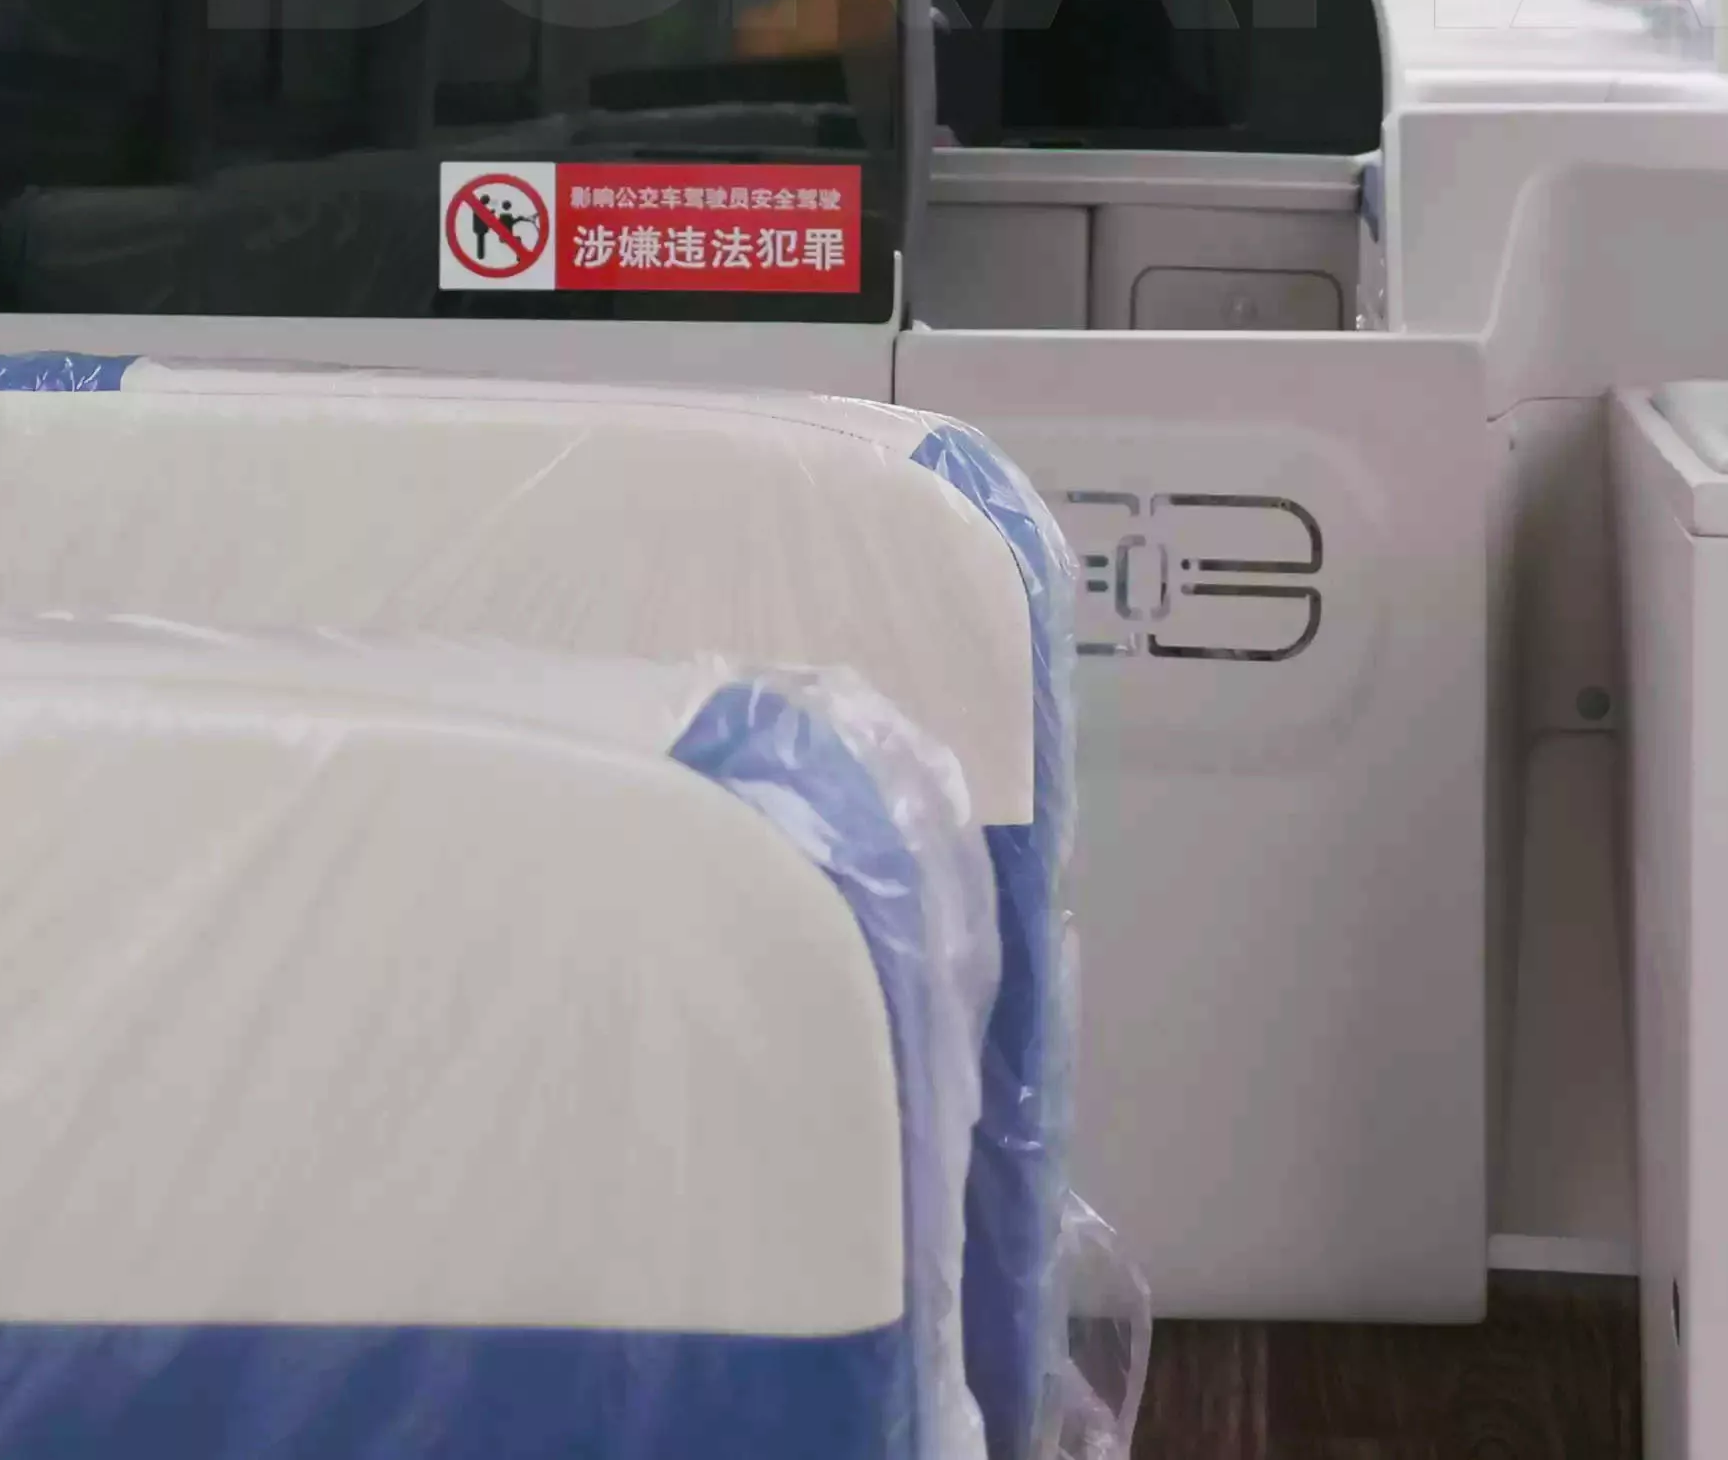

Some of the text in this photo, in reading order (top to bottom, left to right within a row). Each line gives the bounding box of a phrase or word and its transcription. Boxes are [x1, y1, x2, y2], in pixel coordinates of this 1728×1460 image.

[569, 185, 842, 211] 影响公交车驾驶员安全驾驶
[572, 224, 846, 271] 涉嫌违法犯罪
